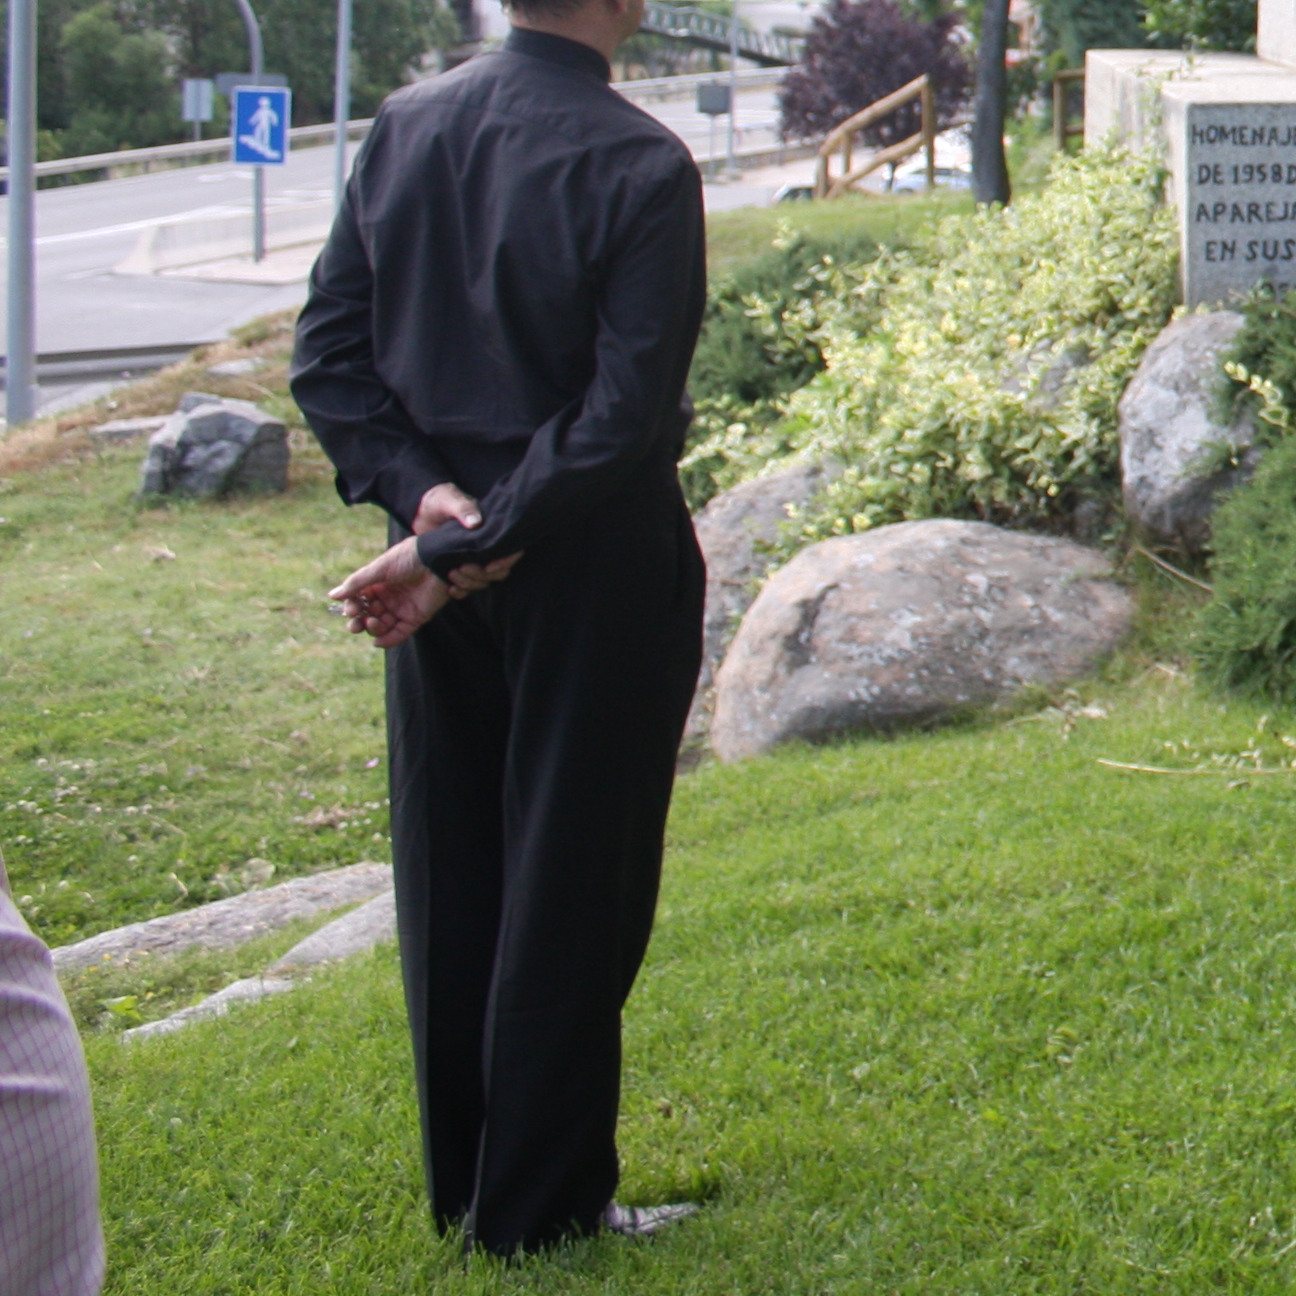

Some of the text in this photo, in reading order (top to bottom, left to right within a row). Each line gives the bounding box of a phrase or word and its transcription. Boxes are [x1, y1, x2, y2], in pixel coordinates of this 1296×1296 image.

[1196, 164, 1224, 185] DE
[1232, 164, 1283, 185] 1958
[1205, 239, 1235, 262] EN
[1245, 239, 1296, 262] SUS
